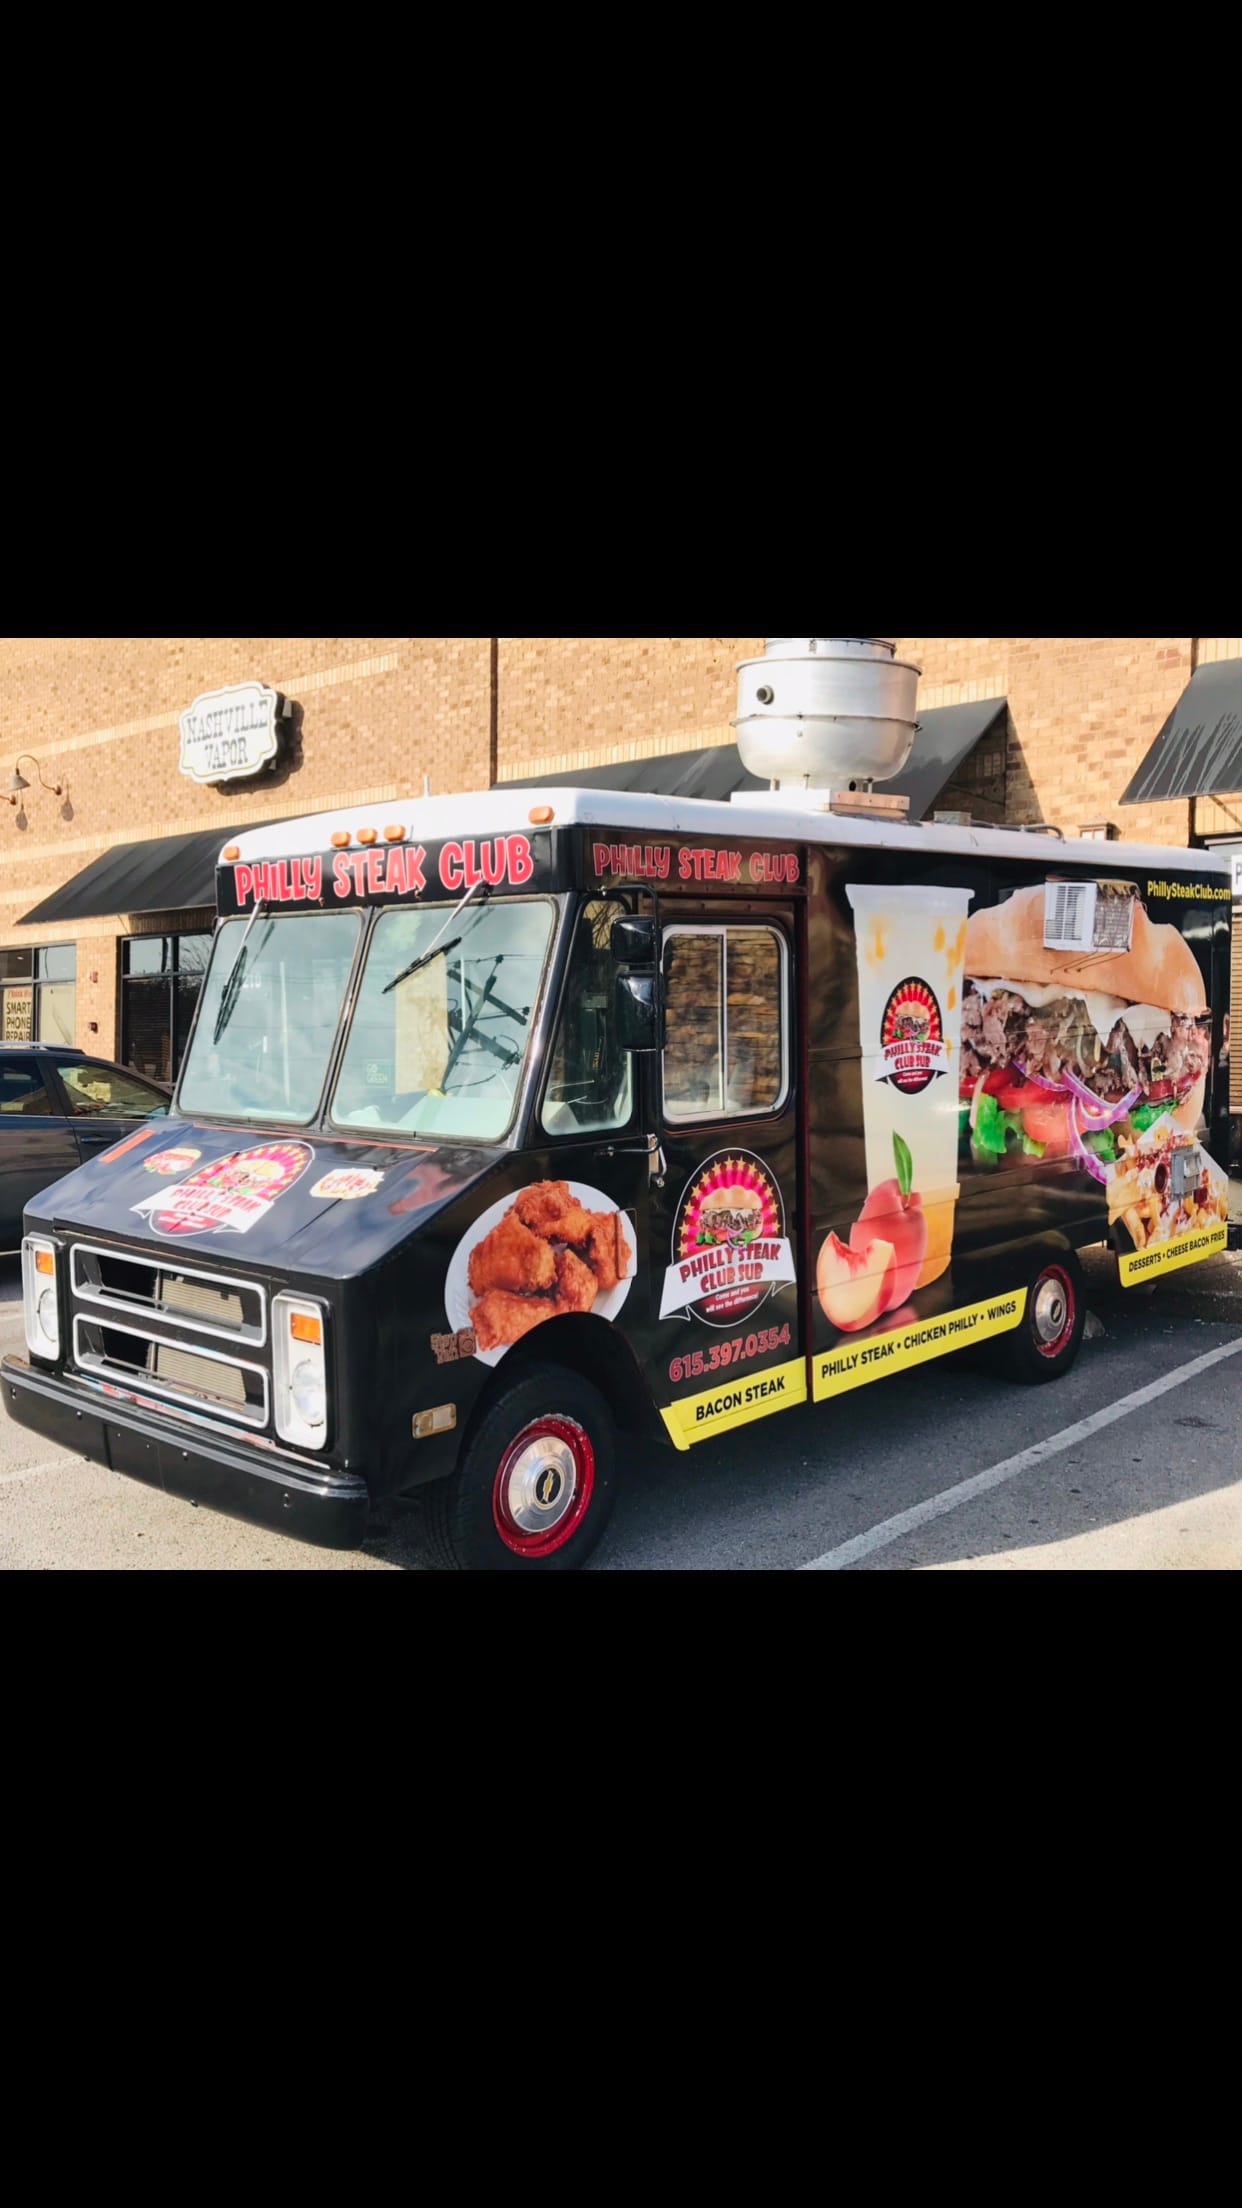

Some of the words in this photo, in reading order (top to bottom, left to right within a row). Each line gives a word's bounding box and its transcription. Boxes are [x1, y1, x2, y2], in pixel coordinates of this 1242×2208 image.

[187, 699, 268, 744] NASHVILLE
[204, 737, 248, 769] VAPOR
[234, 855, 322, 906] PHILLY
[332, 845, 427, 898] STEAK
[438, 834, 534, 890] CLUB
[593, 843, 671, 879] PHILLY
[678, 847, 742, 880] STEAK
[749, 852, 800, 882] CLUB
[1147, 881, 1231, 900] PhillySteakClub.com
[6, 1002, 31, 1014] SMART
[6, 1017, 31, 1029] PHONE
[884, 1043, 916, 1061] PHILLY
[917, 1042, 942, 1057] STEAK
[894, 1055, 915, 1070] CLUB
[679, 1247, 734, 1284] PHILLY
[738, 1242, 781, 1262] STEAK
[1128, 1252, 1162, 1272] DESSERTS
[1166, 1243, 1189, 1259] CHEESE
[1189, 1235, 1210, 1250] BACON
[1210, 1229, 1225, 1245] FRIES
[700, 1266, 735, 1294] CLUB
[738, 1262, 764, 1282] SUB
[669, 1323, 791, 1382] 615.397.0354
[821, 1354, 859, 1378] PHILLY
[861, 1341, 895, 1365] STEAK
[904, 1324, 947, 1350] CHICKEN
[948, 1313, 978, 1334] PHILLY
[987, 1300, 1017, 1321] WINGS
[696, 1391, 742, 1421] BACON
[745, 1376, 785, 1402] STEAK
